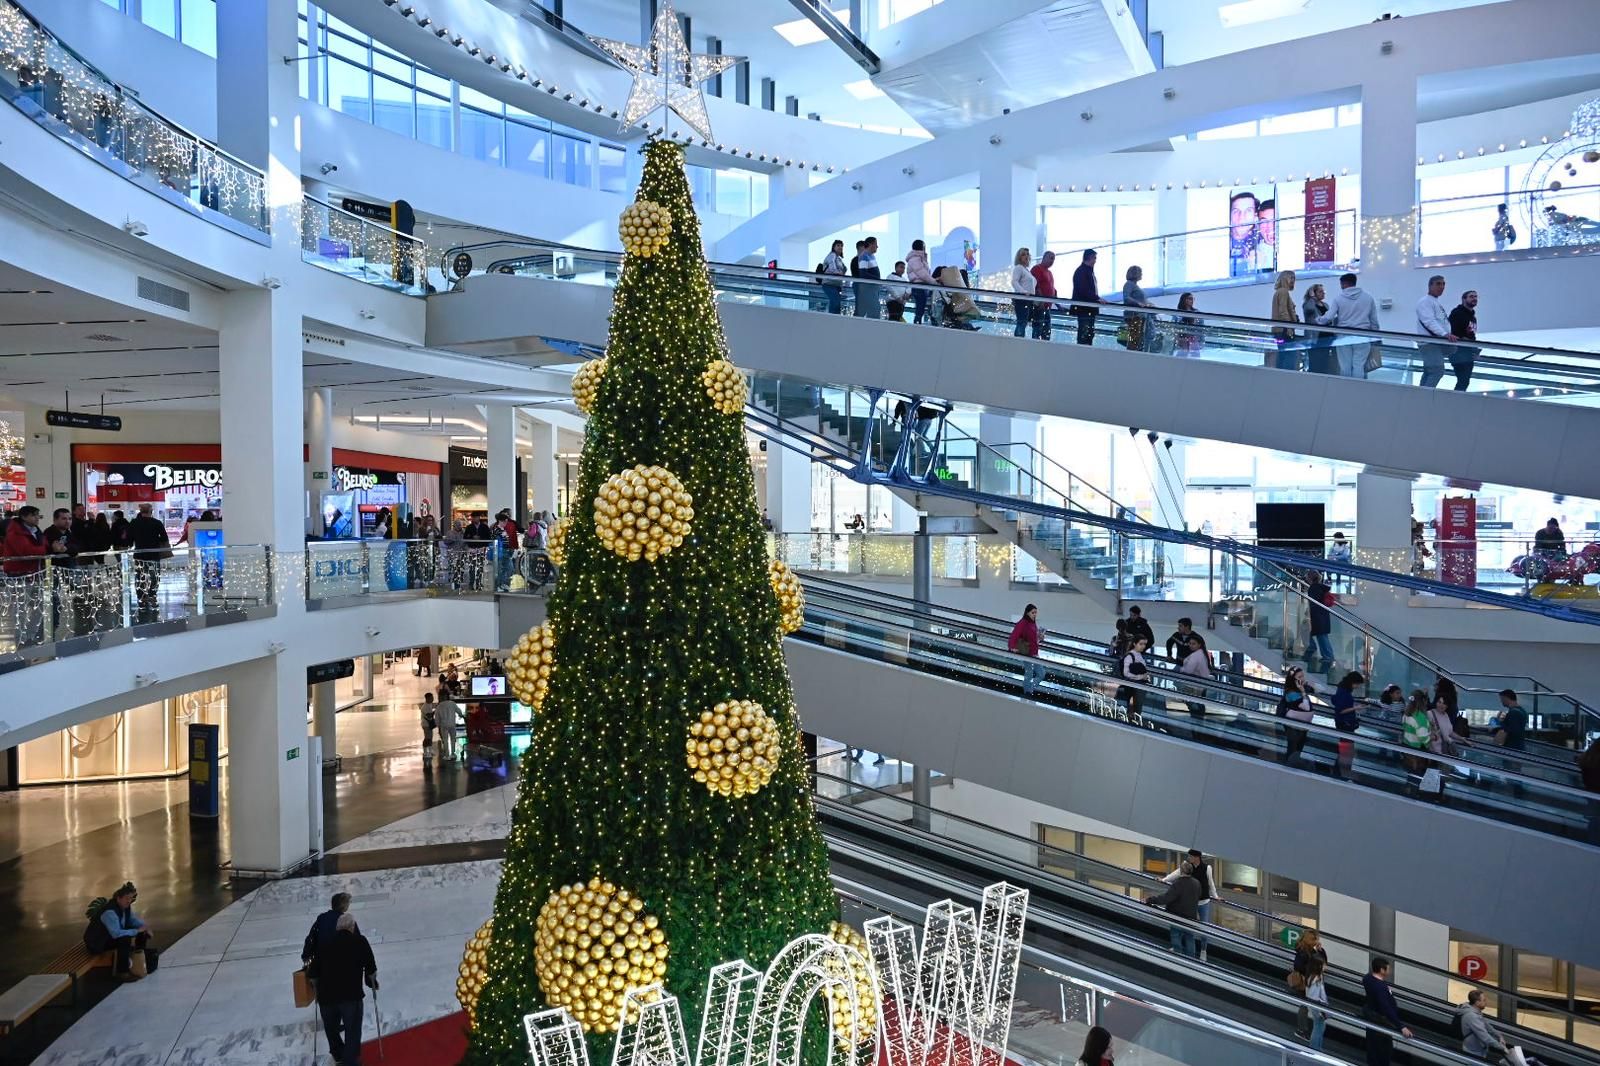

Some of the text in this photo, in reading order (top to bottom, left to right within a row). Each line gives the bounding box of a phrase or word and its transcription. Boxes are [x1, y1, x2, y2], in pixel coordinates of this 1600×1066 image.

[337, 467, 374, 491] BELROS
[1287, 929, 1300, 945] P
[1466, 959, 1480, 976] P
